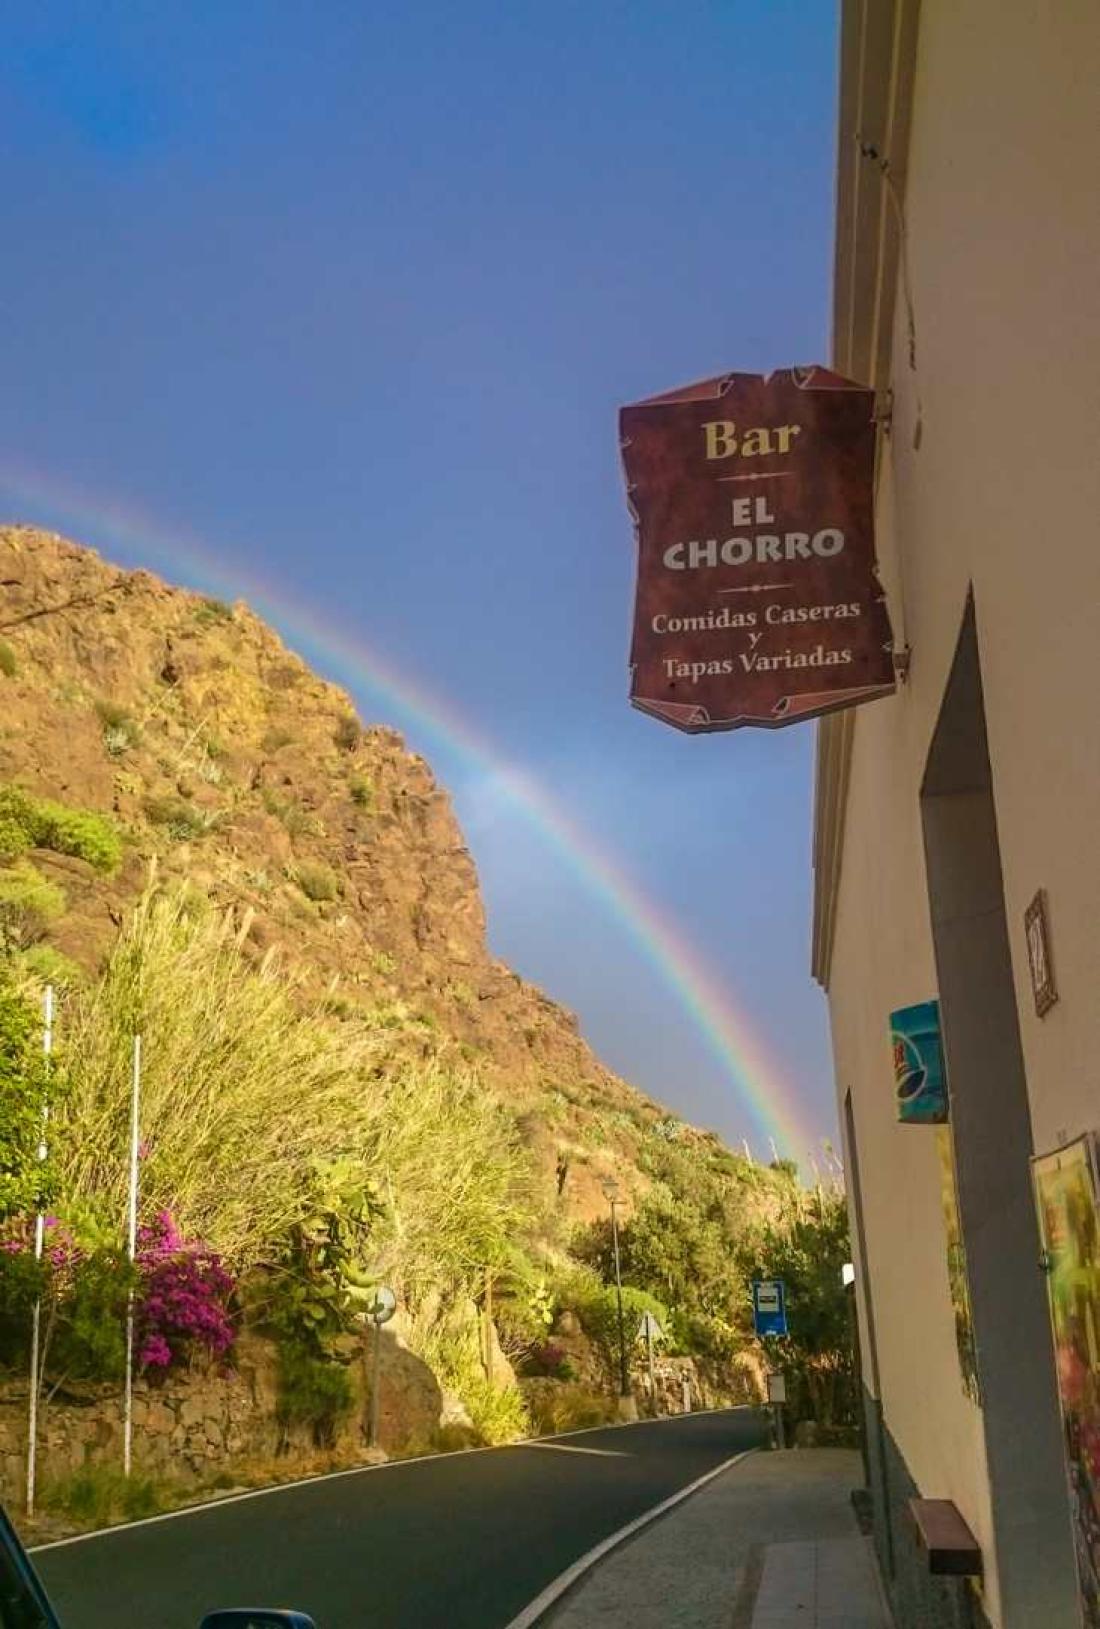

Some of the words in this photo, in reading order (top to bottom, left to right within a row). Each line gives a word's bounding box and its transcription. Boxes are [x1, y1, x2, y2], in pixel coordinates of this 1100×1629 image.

[701, 421, 800, 460] Bar
[732, 497, 774, 527] EL
[663, 528, 845, 570] CHORRO
[652, 607, 757, 634] Comidas
[765, 602, 861, 625] Caseras
[748, 632, 762, 649] y
[663, 656, 733, 684] Tapas
[738, 646, 852, 673] Variadas
